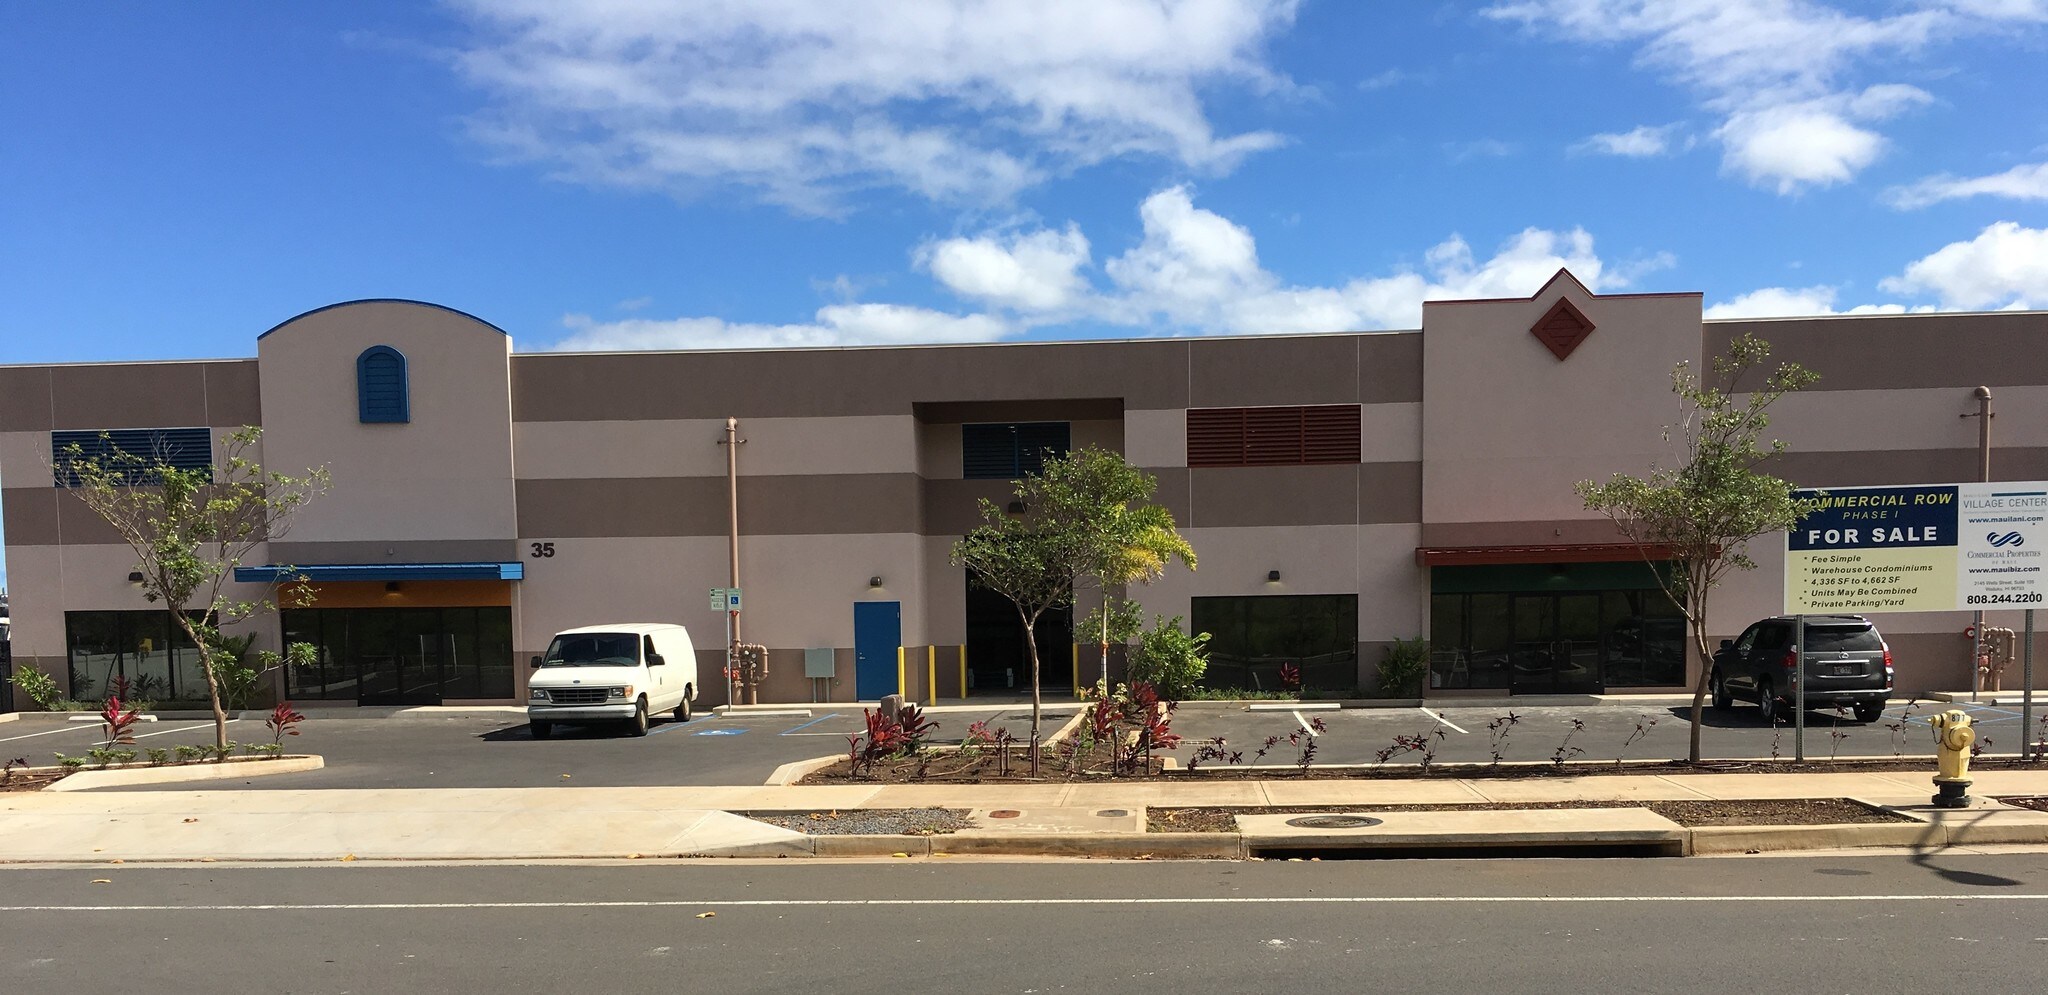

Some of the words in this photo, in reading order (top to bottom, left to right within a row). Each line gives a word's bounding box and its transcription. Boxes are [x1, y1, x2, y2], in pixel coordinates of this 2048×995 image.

[1914, 493, 1953, 505] ROW
[1963, 499, 2004, 509] VILLAGE
[2008, 498, 2047, 507] CENTER
[1843, 510, 1888, 520] PHASE
[1894, 510, 1899, 518] I
[1808, 529, 1859, 544] FOR
[1871, 526, 1937, 543] SALE
[531, 542, 555, 558] 35
[1829, 555, 1862, 563] Simple
[1864, 564, 1933, 573] Condominiums
[1968, 566, 2041, 574] www.mauibiz.com
[1811, 578, 1836, 586] 4,336
[1837, 577, 1850, 585] SF
[1862, 576, 1887, 585] 4,662
[1888, 576, 1901, 584] SF
[1811, 589, 1835, 597] Units
[1837, 588, 1856, 597] May
[1857, 588, 1870, 596] Be
[1871, 587, 1918, 595] Combined
[1811, 600, 1844, 608] Private
[1845, 599, 1905, 608] Parking/Yard
[1967, 594, 2043, 604] 808.244.2200
